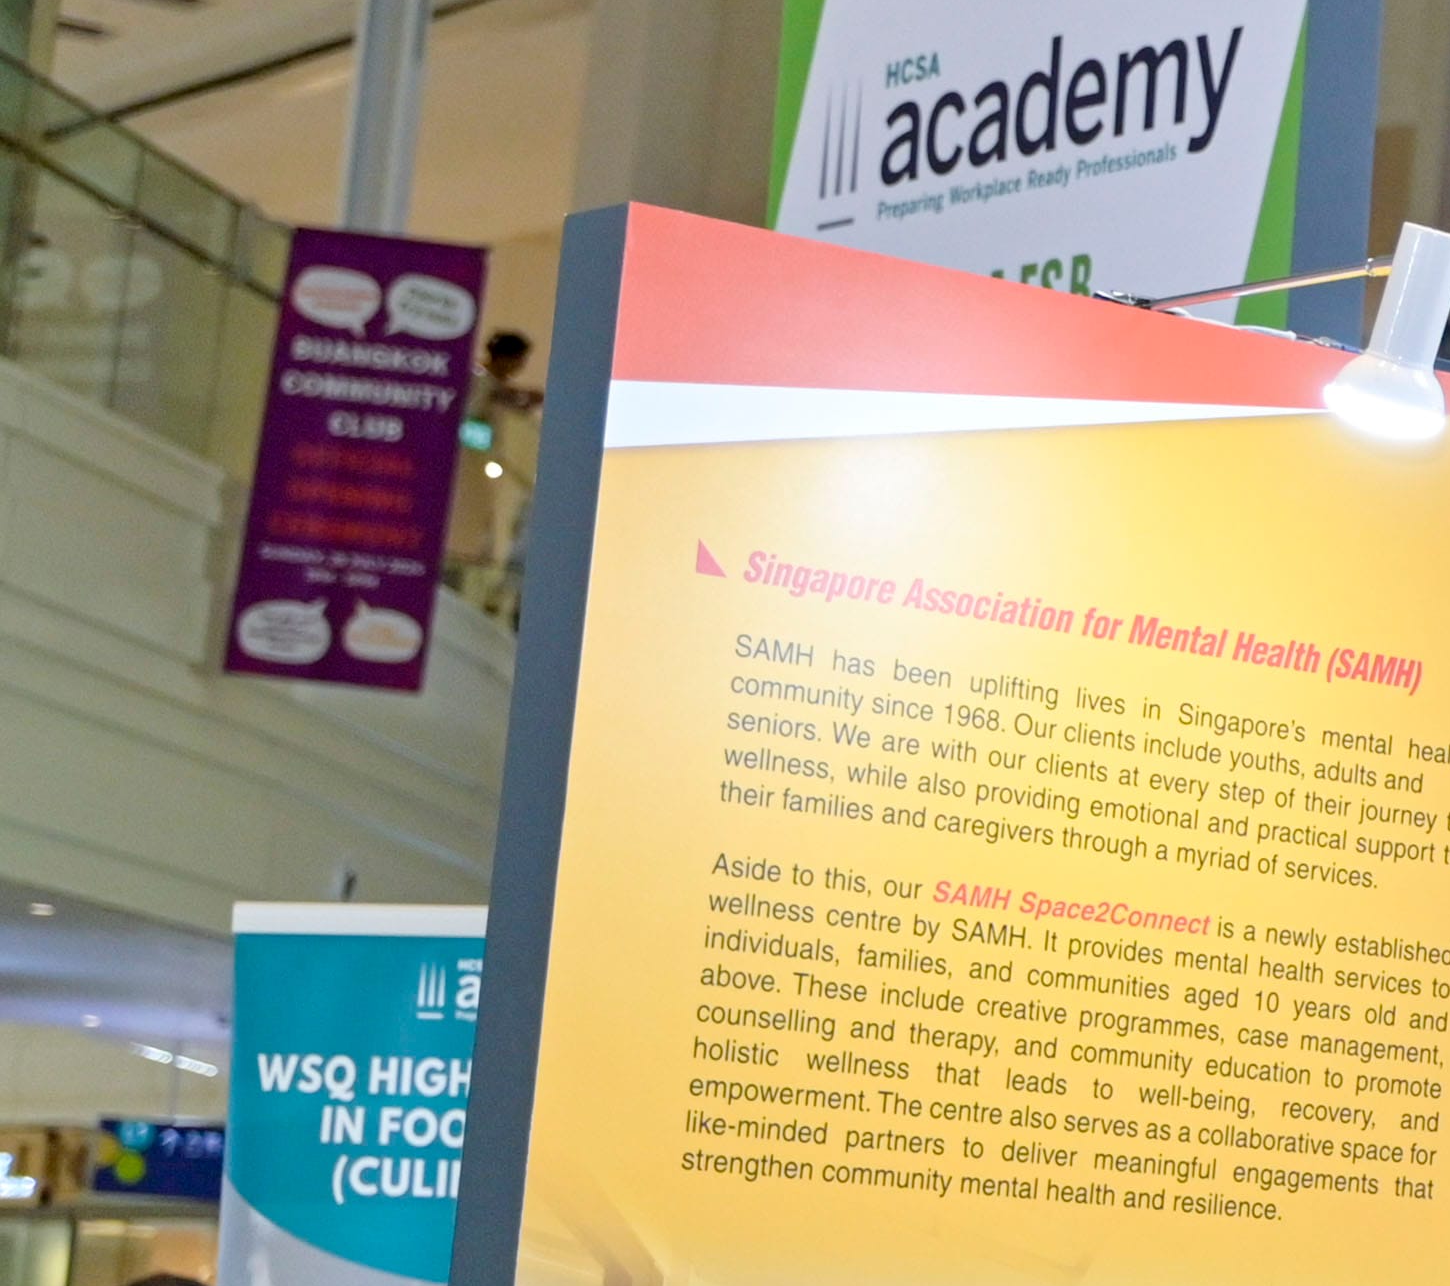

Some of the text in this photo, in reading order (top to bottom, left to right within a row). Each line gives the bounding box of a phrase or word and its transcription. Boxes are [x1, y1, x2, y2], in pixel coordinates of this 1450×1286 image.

[880, 26, 1243, 187] academy
[885, 52, 941, 88] HCSA
[877, 142, 1177, 222] Preparing Workplace Ready Professionals
[743, 549, 1424, 697] Singapore Association for Mental Health (SAMH)
[734, 633, 814, 668] SAMH
[832, 649, 876, 677] has
[893, 658, 952, 689] been
[969, 674, 1059, 711] uplifting
[1075, 686, 1126, 716] lives
[1142, 702, 1161, 721] in
[1178, 702, 1306, 743] Singapore’s
[1321, 729, 1393, 756] mental
[258, 1053, 356, 1100] WSQ
[320, 1105, 364, 1144] IN
[680, 1148, 1283, 1222] strengthen community mental health and resilience.
